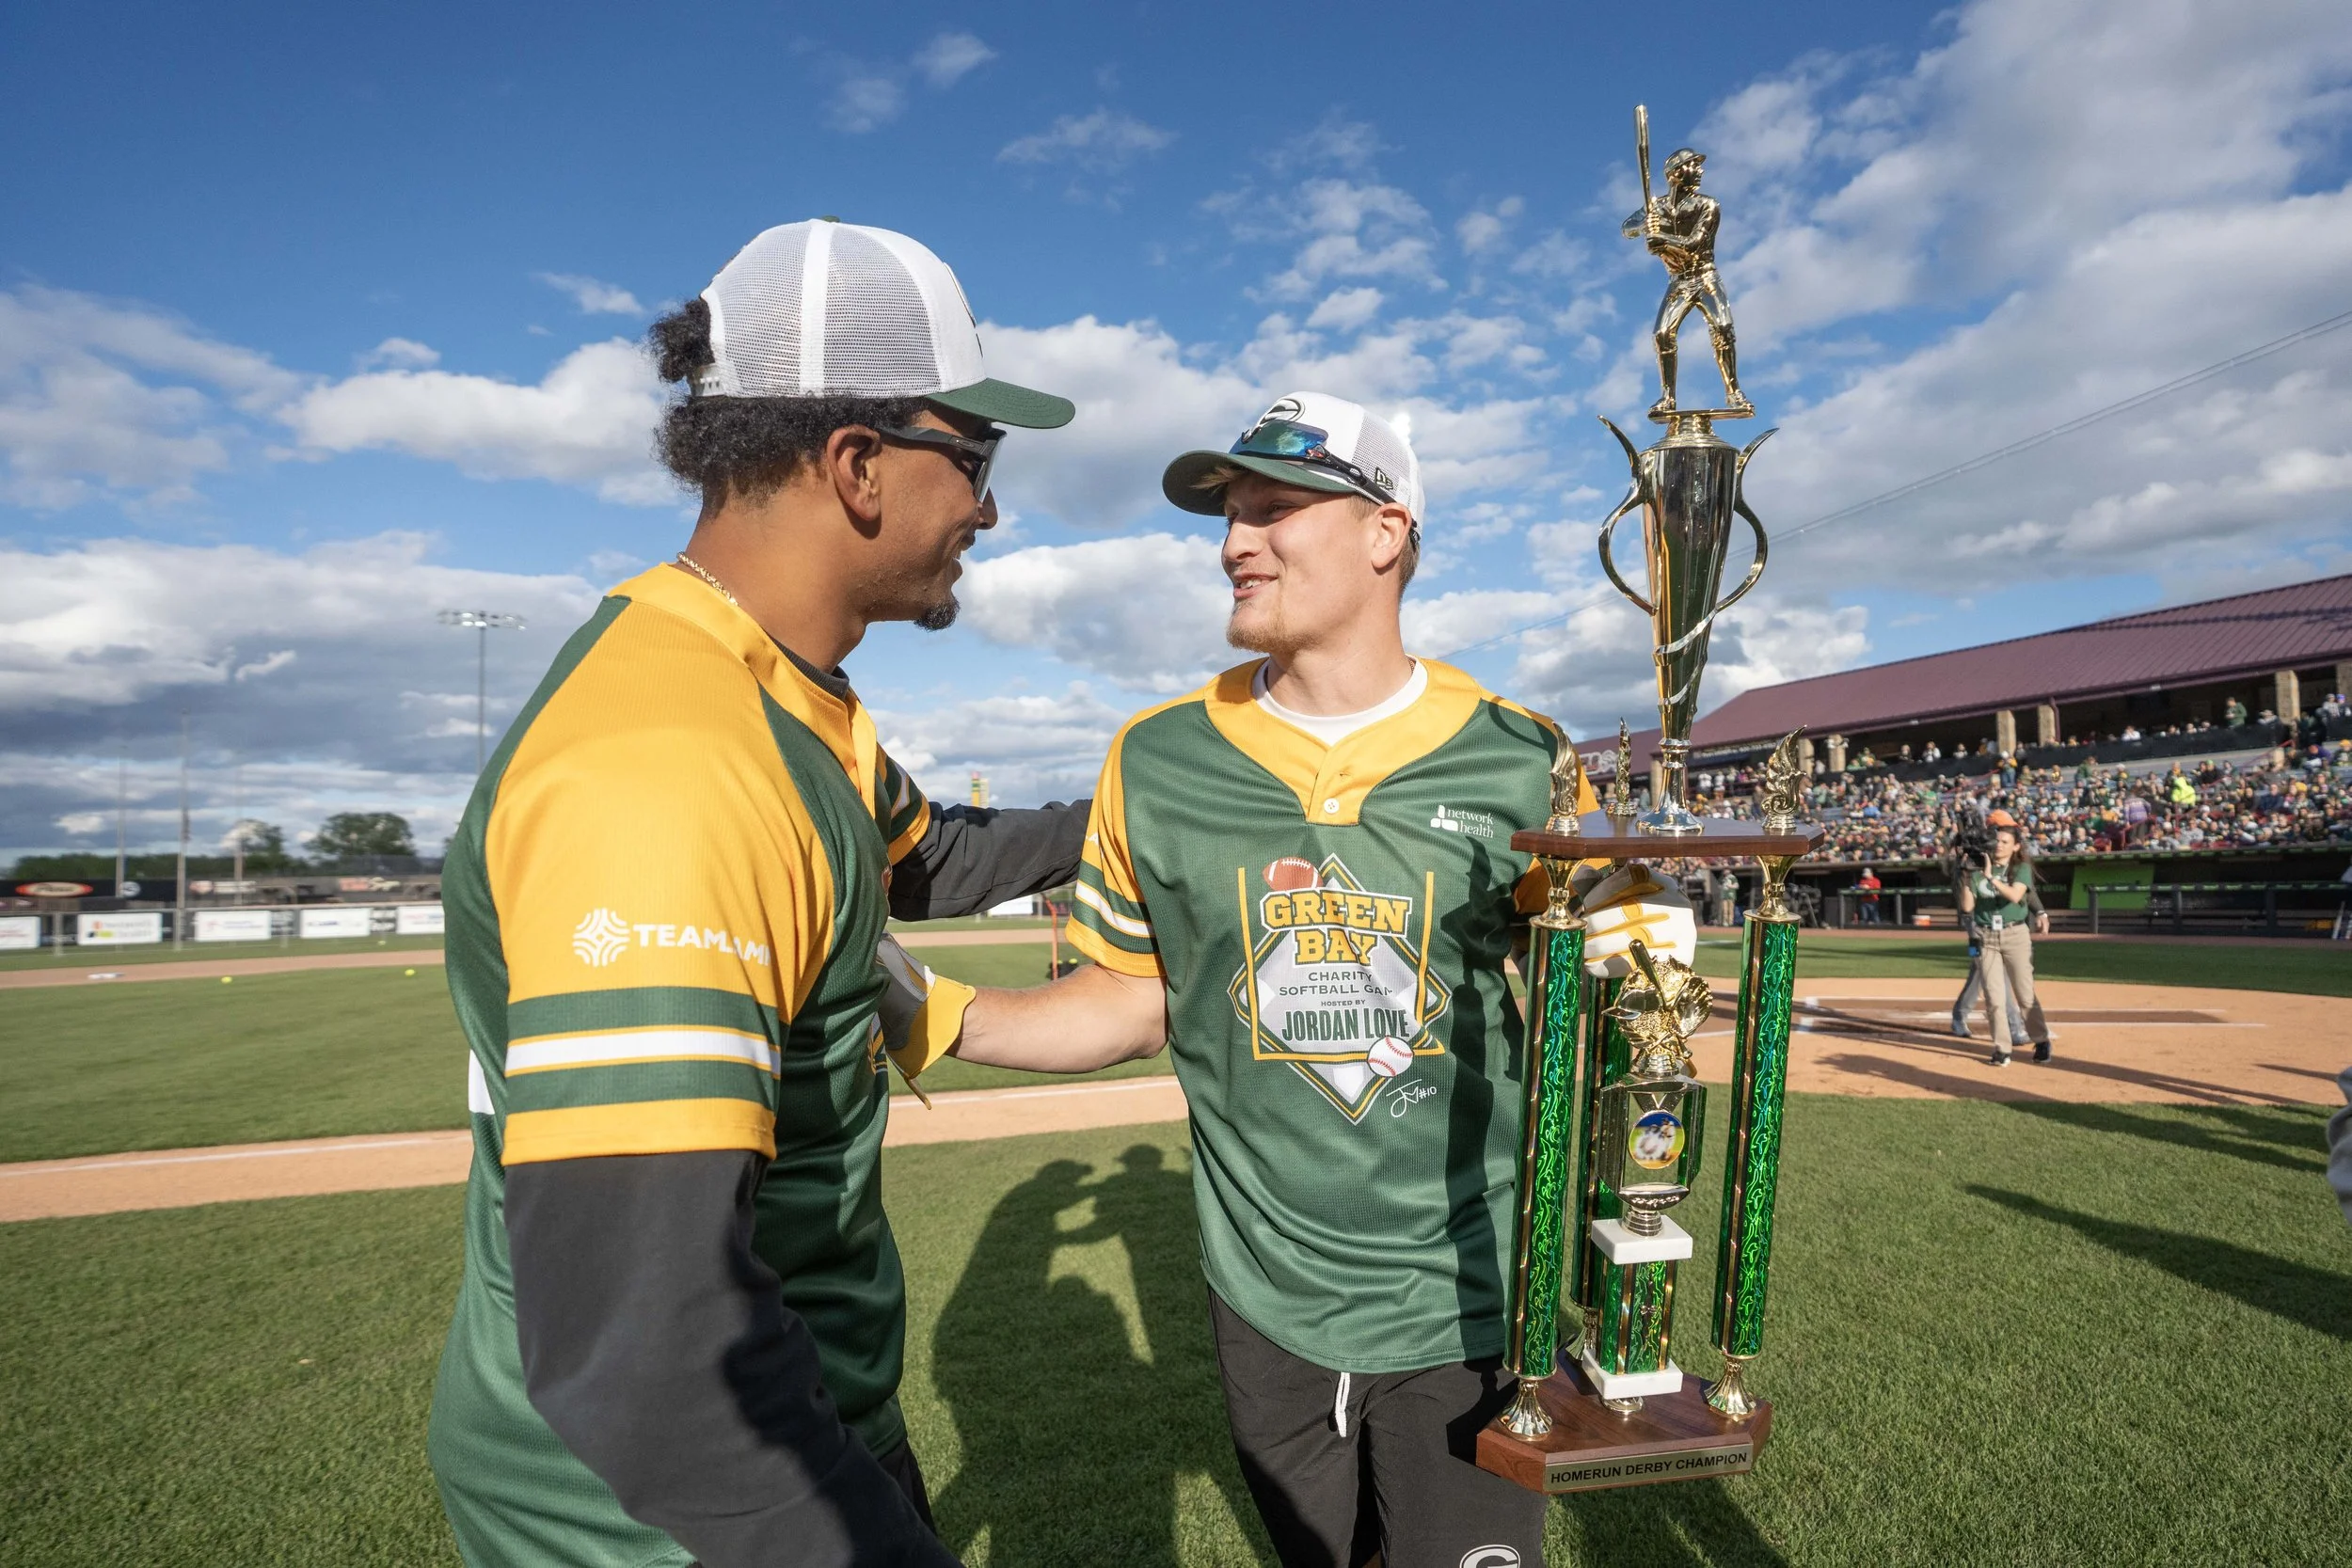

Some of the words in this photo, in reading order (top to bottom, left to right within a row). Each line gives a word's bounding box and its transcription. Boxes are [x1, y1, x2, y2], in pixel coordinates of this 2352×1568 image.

[1447, 809, 1494, 825] network
[1459, 820, 1494, 838] health
[1263, 890, 1409, 935] GREEN
[1295, 927, 1377, 967] BAY
[1308, 971, 1373, 982] CHARITY
[1279, 984, 1359, 996] SOFTBALL
[1281, 1008, 1359, 1041] JORDAN
[1363, 1007, 1410, 1038] LOVE
[1550, 1466, 1621, 1484] HOMERUN
[1626, 1461, 1673, 1475] DERBY
[1676, 1452, 1747, 1470] CHAMPION
